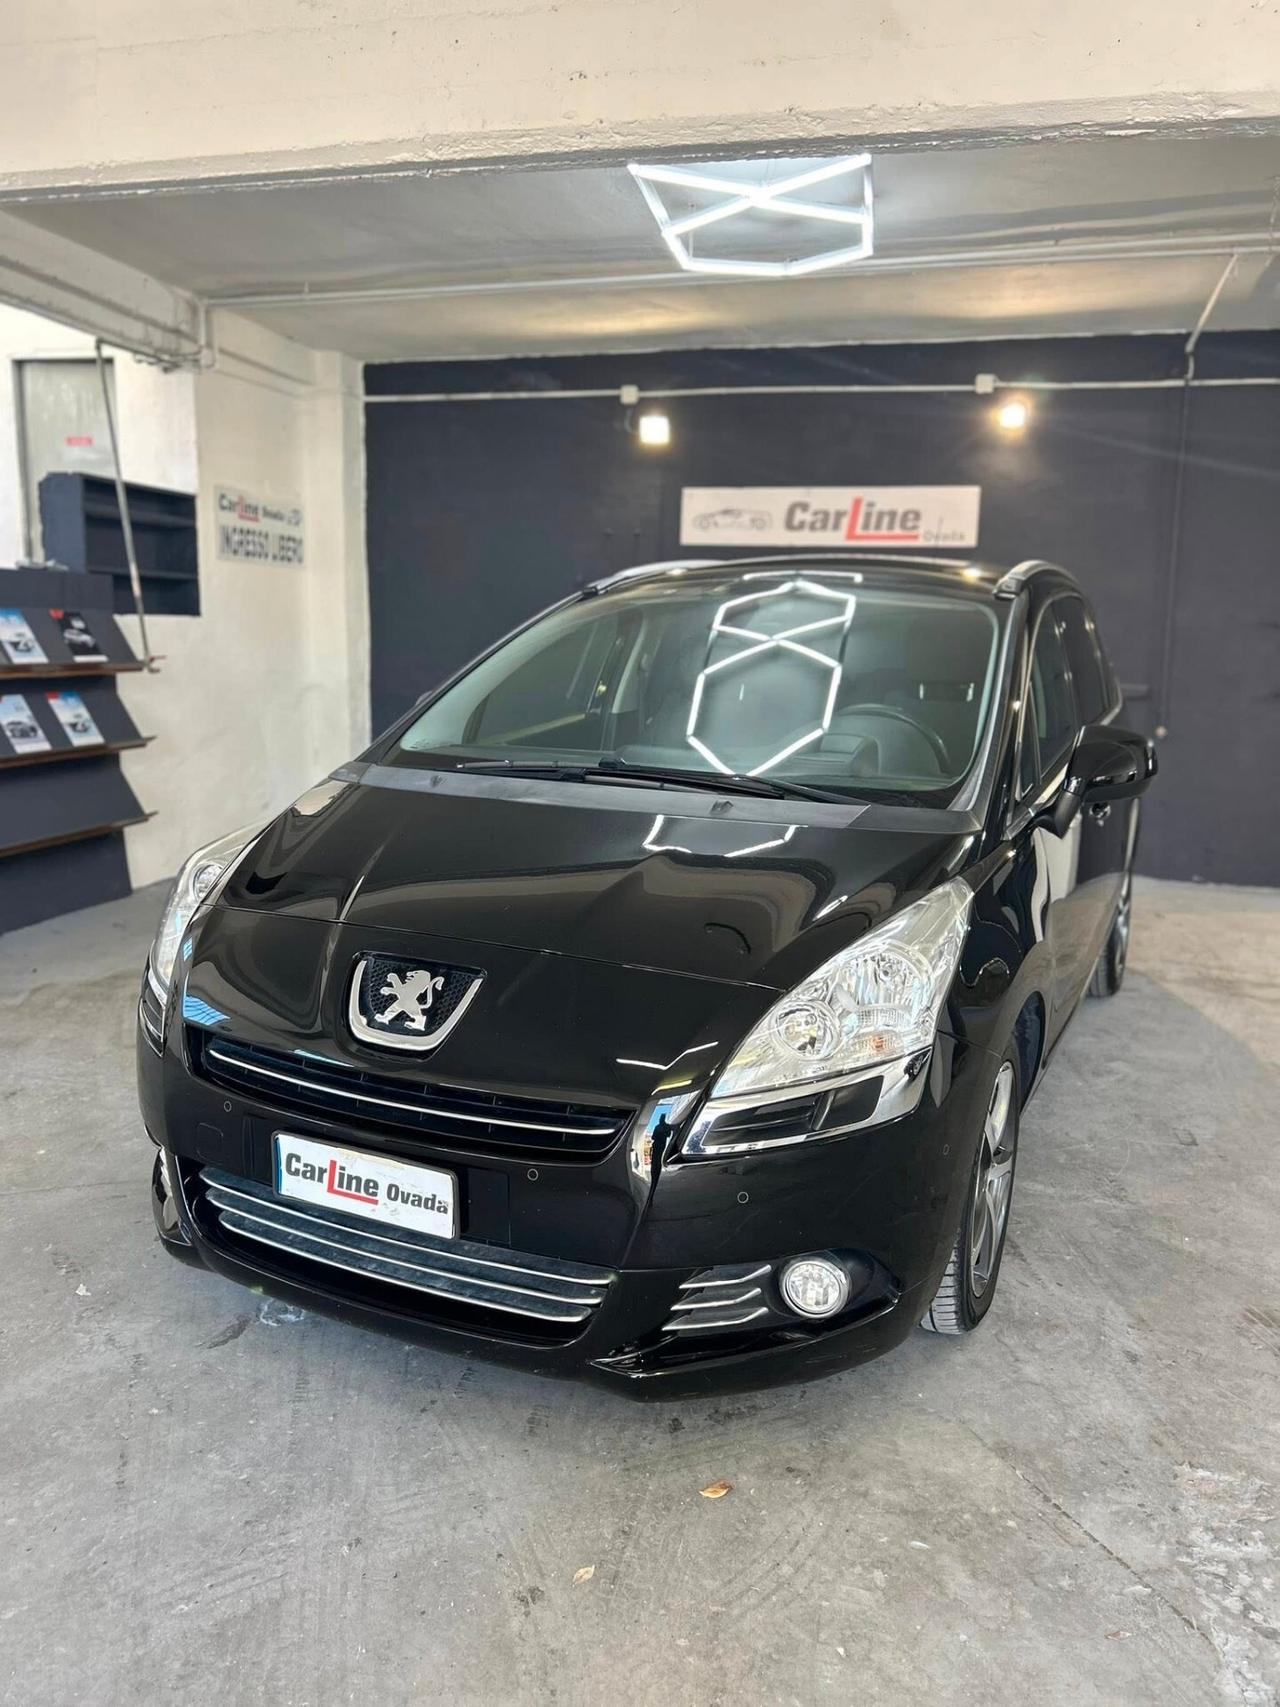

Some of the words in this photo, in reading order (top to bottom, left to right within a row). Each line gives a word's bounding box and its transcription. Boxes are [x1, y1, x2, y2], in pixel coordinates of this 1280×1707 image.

[784, 497, 922, 541] CarLine
[285, 1153, 379, 1206] CarLine
[386, 1183, 448, 1215] Ovada
